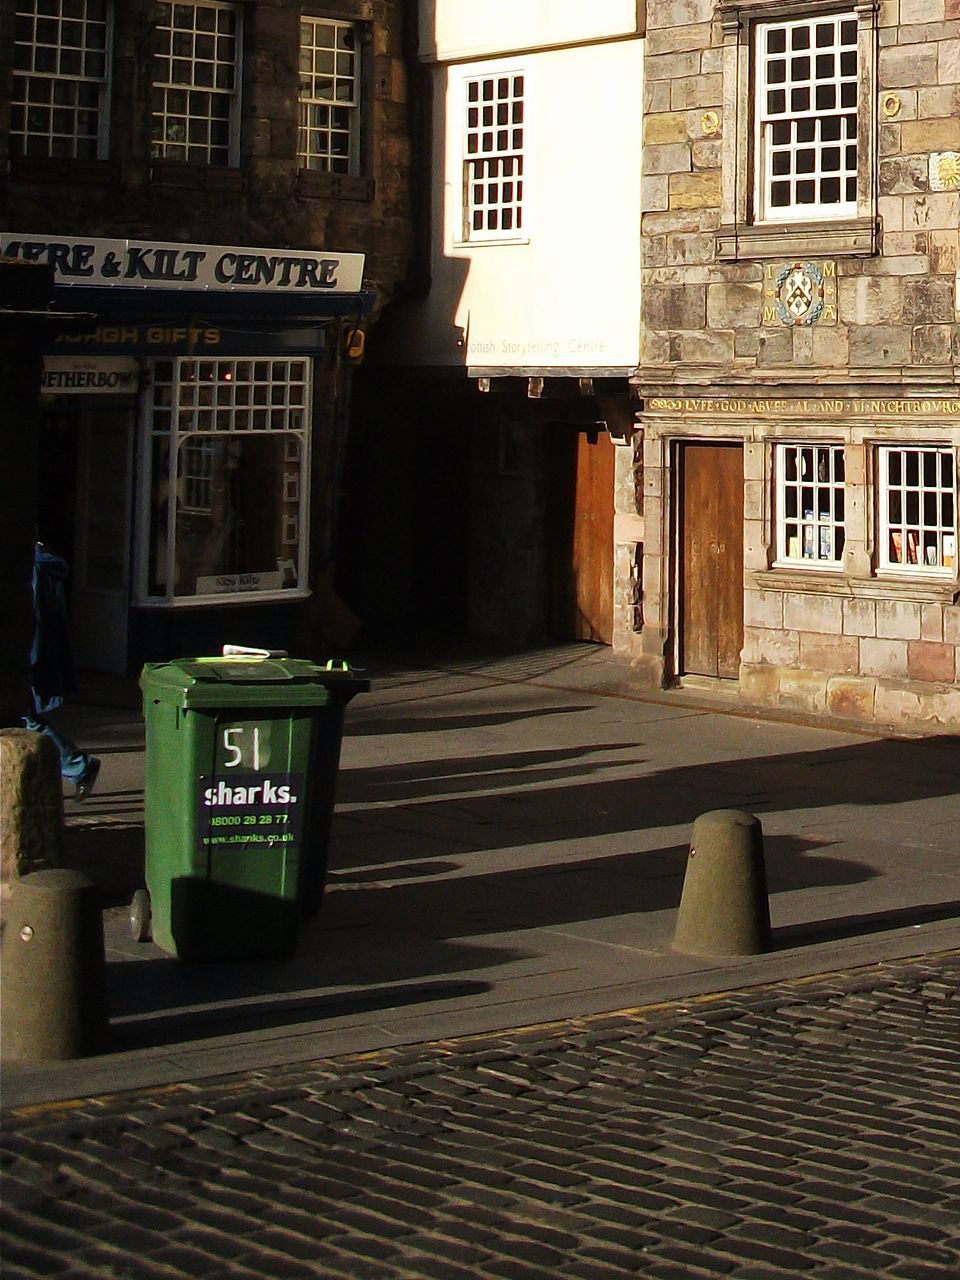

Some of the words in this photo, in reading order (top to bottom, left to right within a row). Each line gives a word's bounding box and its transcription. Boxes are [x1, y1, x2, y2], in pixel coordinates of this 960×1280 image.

[101, 251, 121, 278] &
[126, 247, 206, 281] KILT
[214, 253, 340, 288] CENTRE
[146, 327, 221, 344] GIFTS
[569, 339, 606, 353] Centre
[721, 401, 746, 411] GOD
[224, 727, 259, 771] 51
[258, 815, 272, 824] 28
